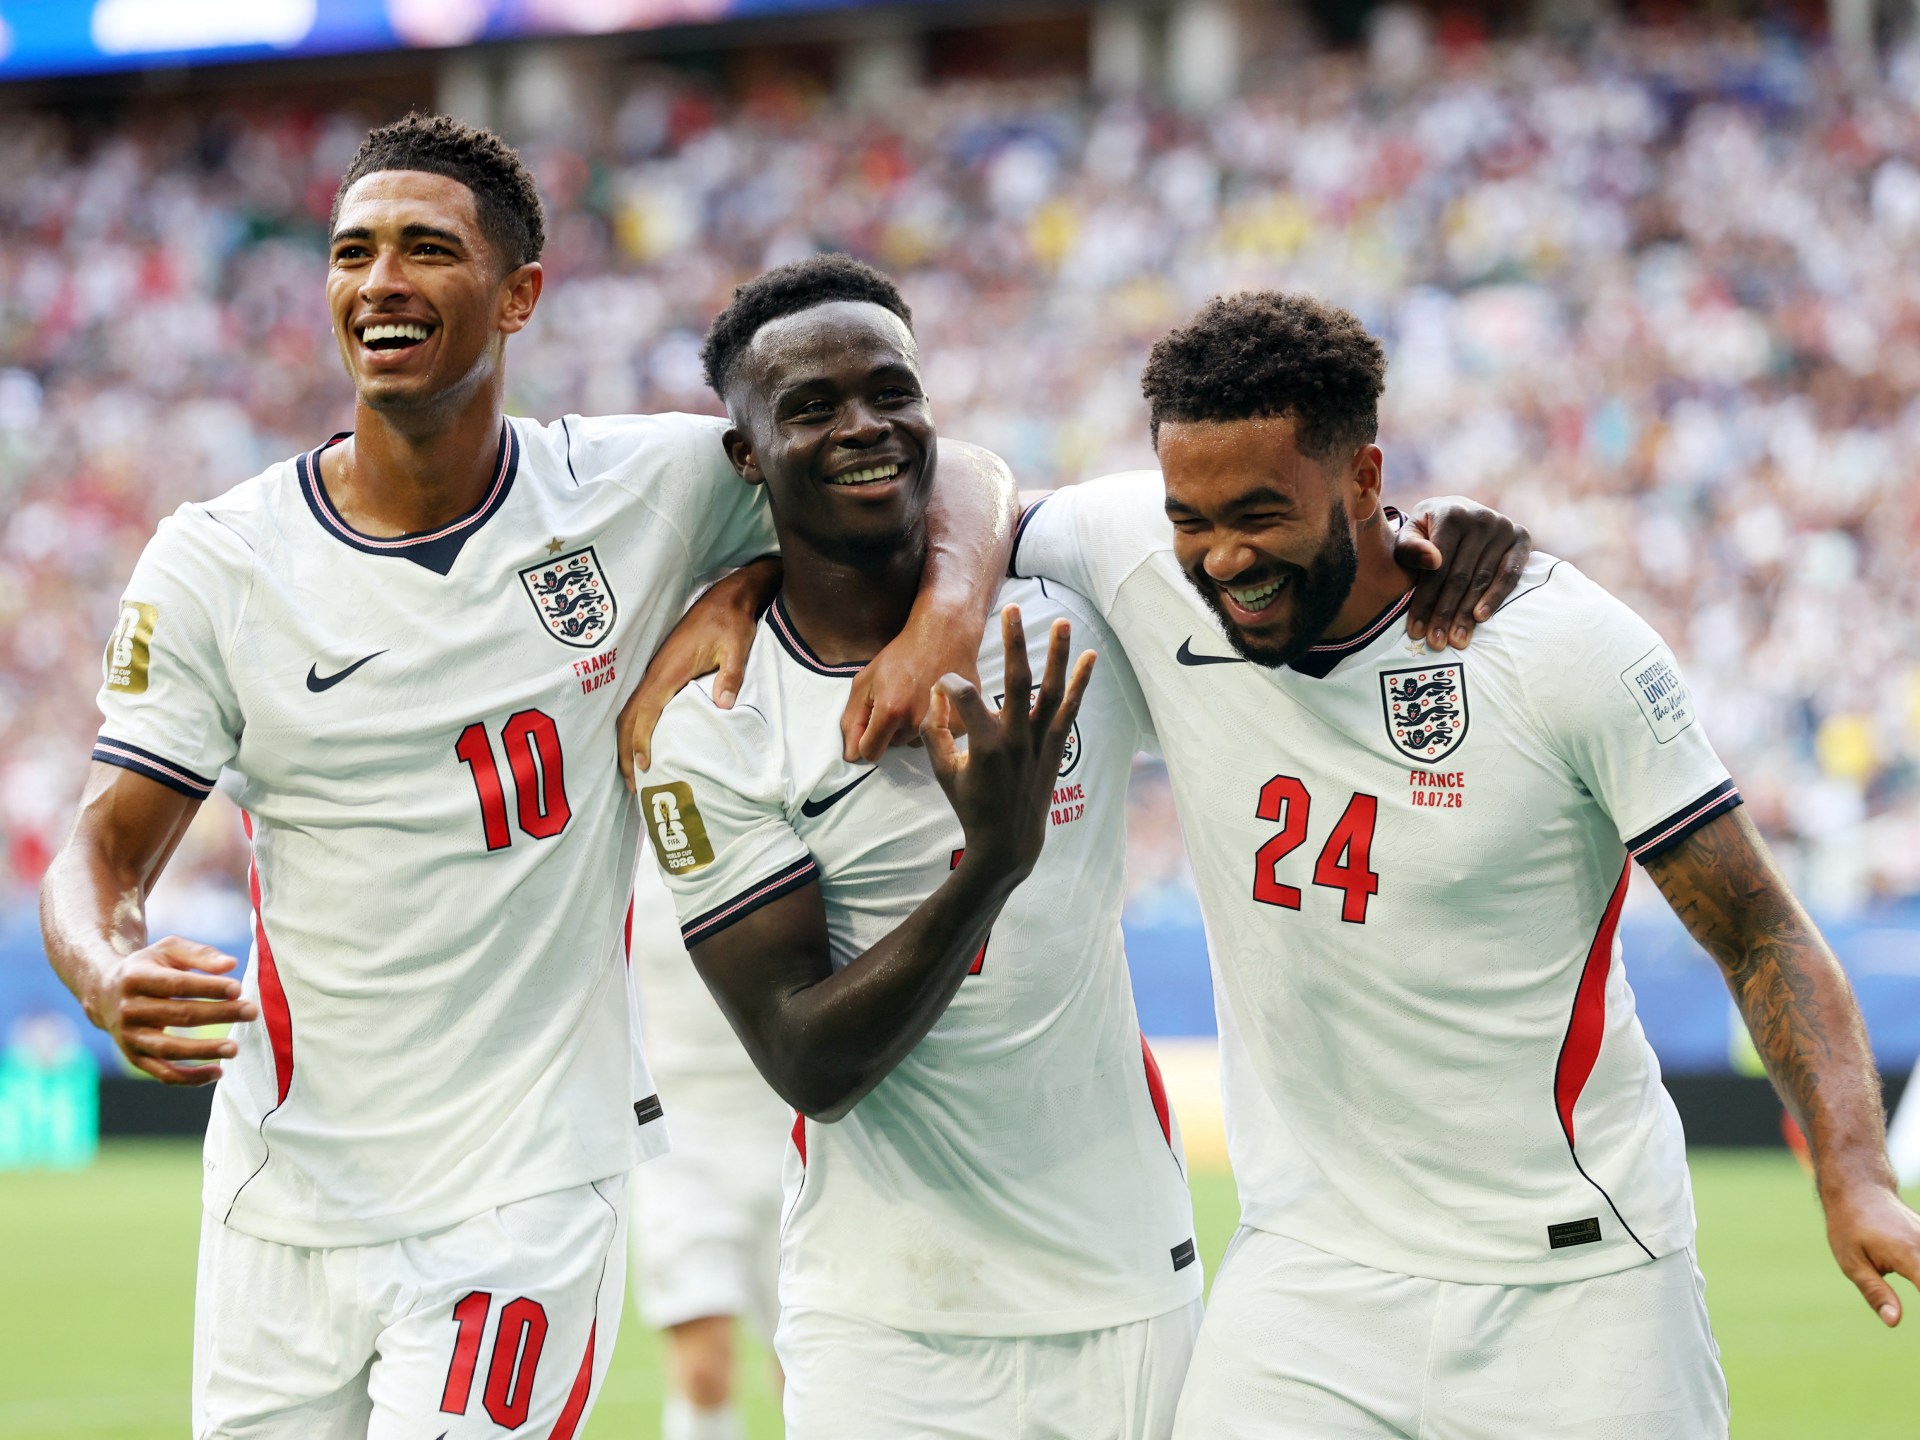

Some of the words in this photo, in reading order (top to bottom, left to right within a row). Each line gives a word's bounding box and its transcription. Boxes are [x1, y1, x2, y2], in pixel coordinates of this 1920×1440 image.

[573, 647, 618, 677] FRANCE
[1635, 657, 1669, 688] FOOTBALL
[581, 666, 616, 695] 18.07.26
[1643, 669, 1679, 704] UNITES
[1652, 704, 1669, 721] the
[1672, 708, 1686, 722] FIFA
[455, 708, 572, 852] 10
[1409, 770, 1465, 788] FRANCE
[1052, 783, 1085, 805] RANCE
[1411, 790, 1462, 808] 18.07.26
[667, 838, 681, 846] FIFA
[681, 849, 693, 857] CUP
[1253, 774, 1379, 924] 24
[668, 856, 696, 869] 2026
[439, 1290, 549, 1431] 10
